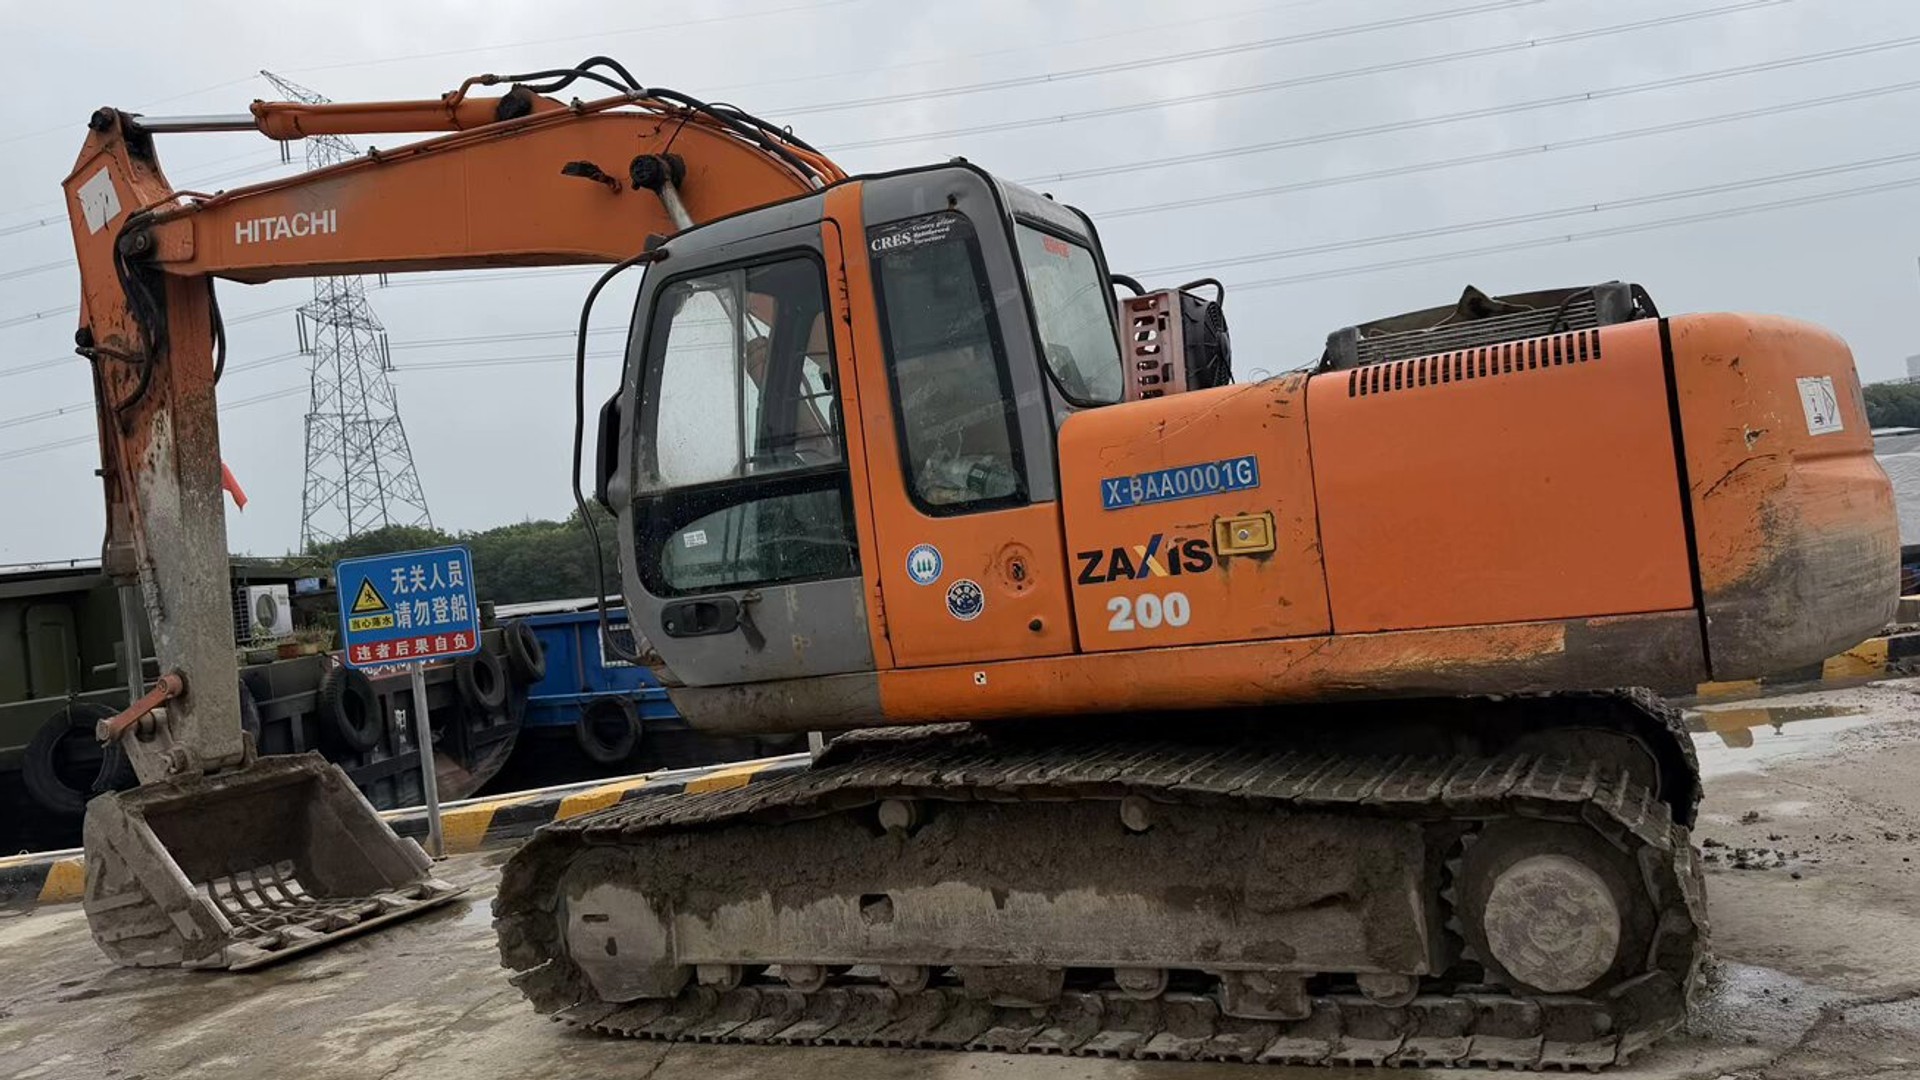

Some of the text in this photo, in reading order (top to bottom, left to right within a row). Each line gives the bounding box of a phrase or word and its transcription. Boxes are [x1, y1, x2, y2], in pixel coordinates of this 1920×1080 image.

[235, 209, 337, 244] HITACHI
[871, 231, 911, 251] CRES
[1107, 459, 1252, 504] X-BAA0001G
[391, 560, 464, 594] 无关人员
[394, 594, 469, 628] 请勿登船
[1107, 591, 1191, 631] 200
[356, 633, 468, 661] 违者后果自负
